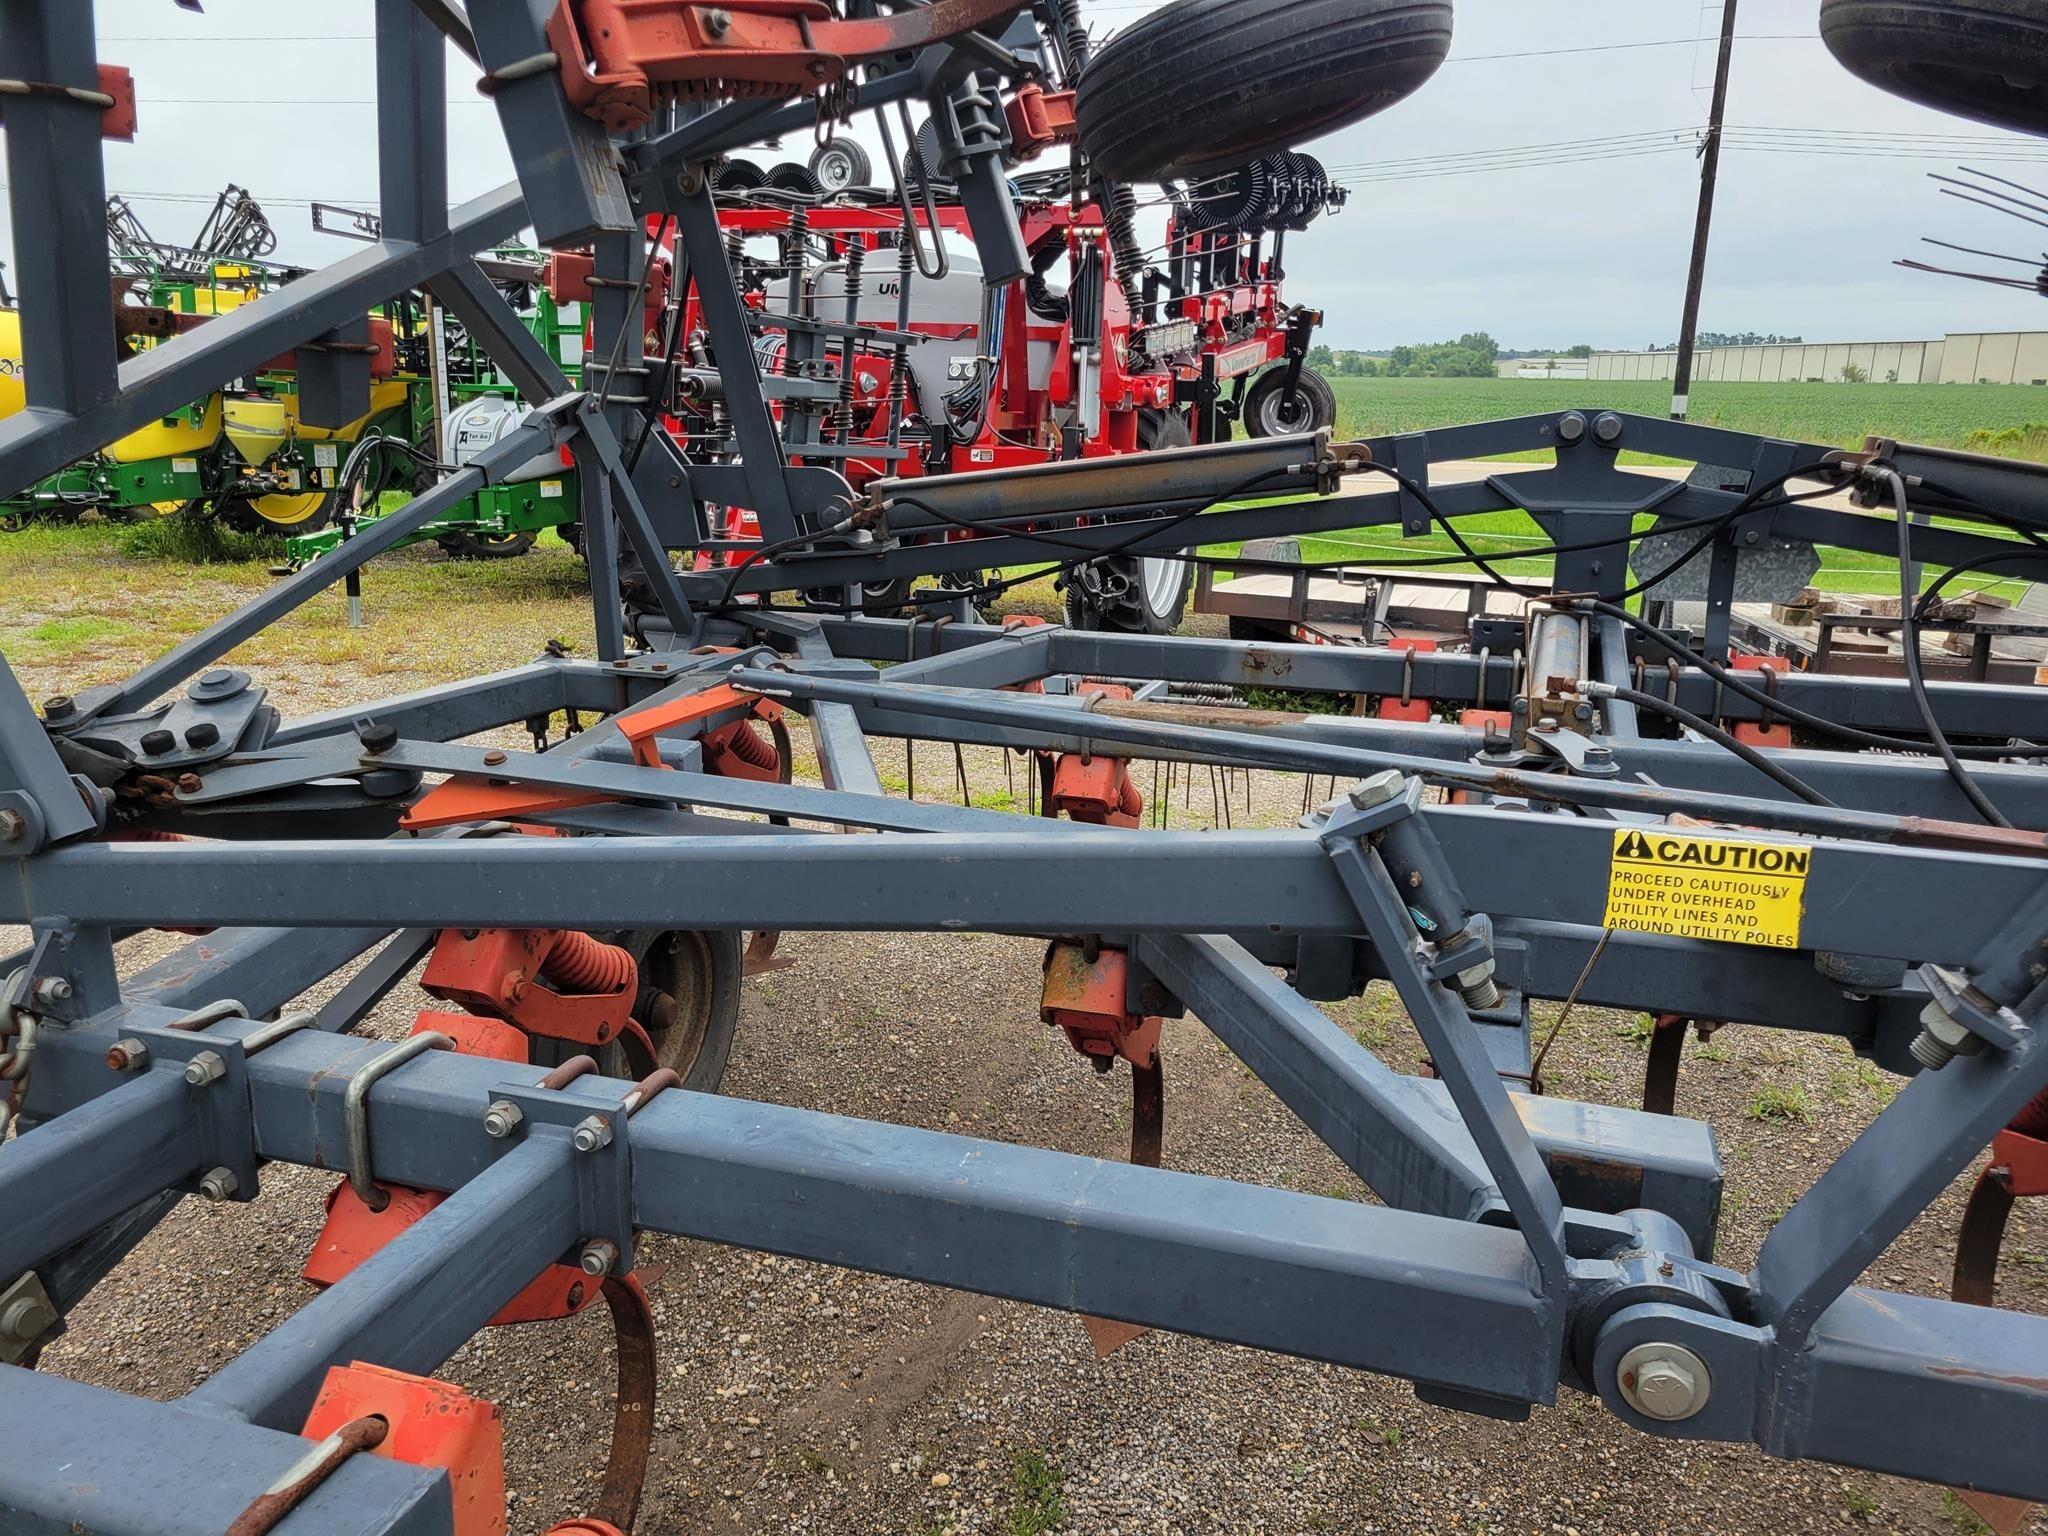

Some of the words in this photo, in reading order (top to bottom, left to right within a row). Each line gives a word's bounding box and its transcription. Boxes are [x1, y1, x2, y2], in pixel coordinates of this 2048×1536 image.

[1657, 841, 1807, 873] CAUTION
[1614, 871, 1684, 888] PROCEED
[1690, 878, 1790, 898] CAUTIOUSLY
[1613, 887, 1665, 901] UNDER
[1671, 892, 1756, 911] OVERHEAD
[1611, 902, 1668, 917] UTILITY
[1674, 908, 1718, 923] LINES
[1724, 914, 1758, 927] AND
[1609, 917, 1673, 934] AROUND
[1680, 925, 1740, 941] UTILITY
[1746, 931, 1793, 946] POLES
